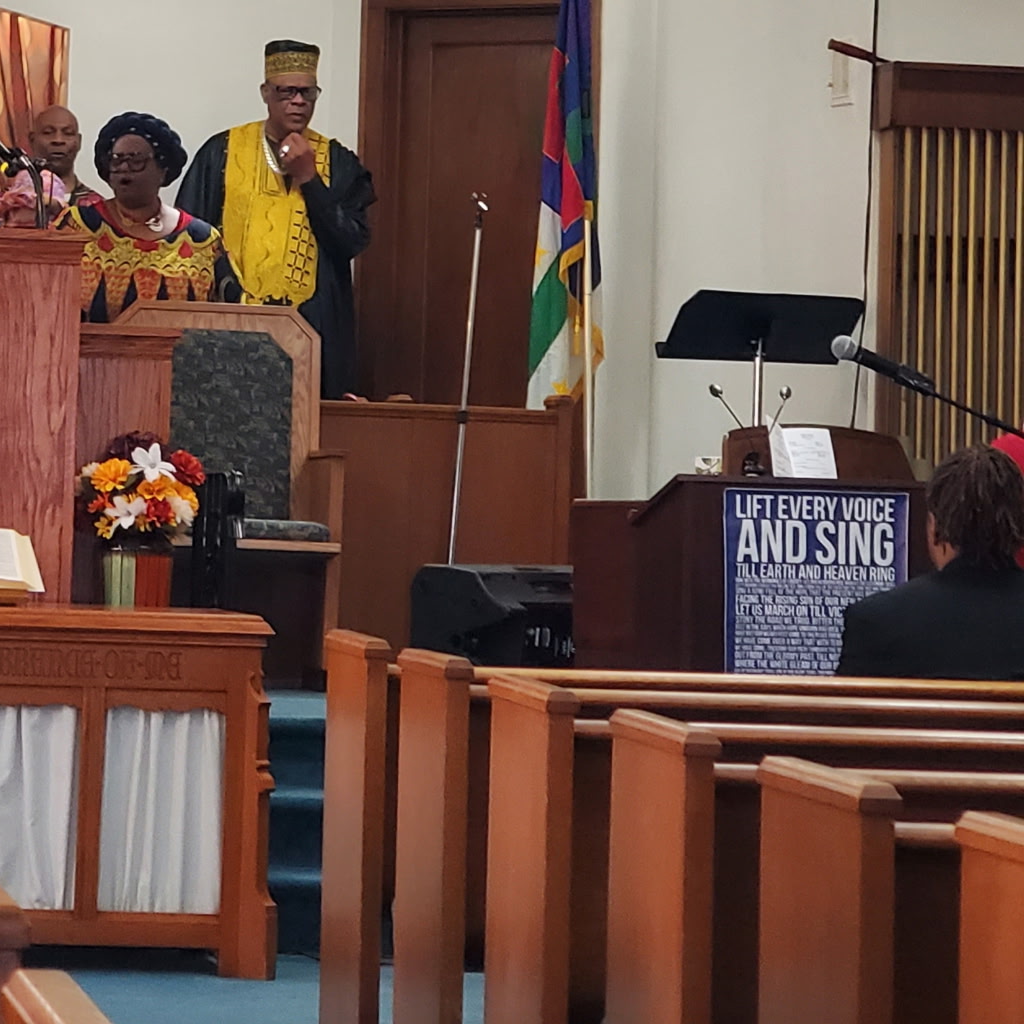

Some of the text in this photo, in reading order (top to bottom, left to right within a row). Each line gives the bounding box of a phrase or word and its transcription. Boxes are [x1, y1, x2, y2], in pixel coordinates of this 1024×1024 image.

[735, 494, 896, 522] LIFT EVERY VOICE
[736, 519, 895, 566] AND SING
[736, 563, 758, 578] TILL
[760, 563, 796, 580] EARTH
[798, 564, 821, 580] AND
[824, 565, 867, 581] HEAVEN
[869, 566, 896, 582] RING
[760, 595, 774, 605] THE
[736, 604, 846, 618] LET US MARCH ON TILL VIC
